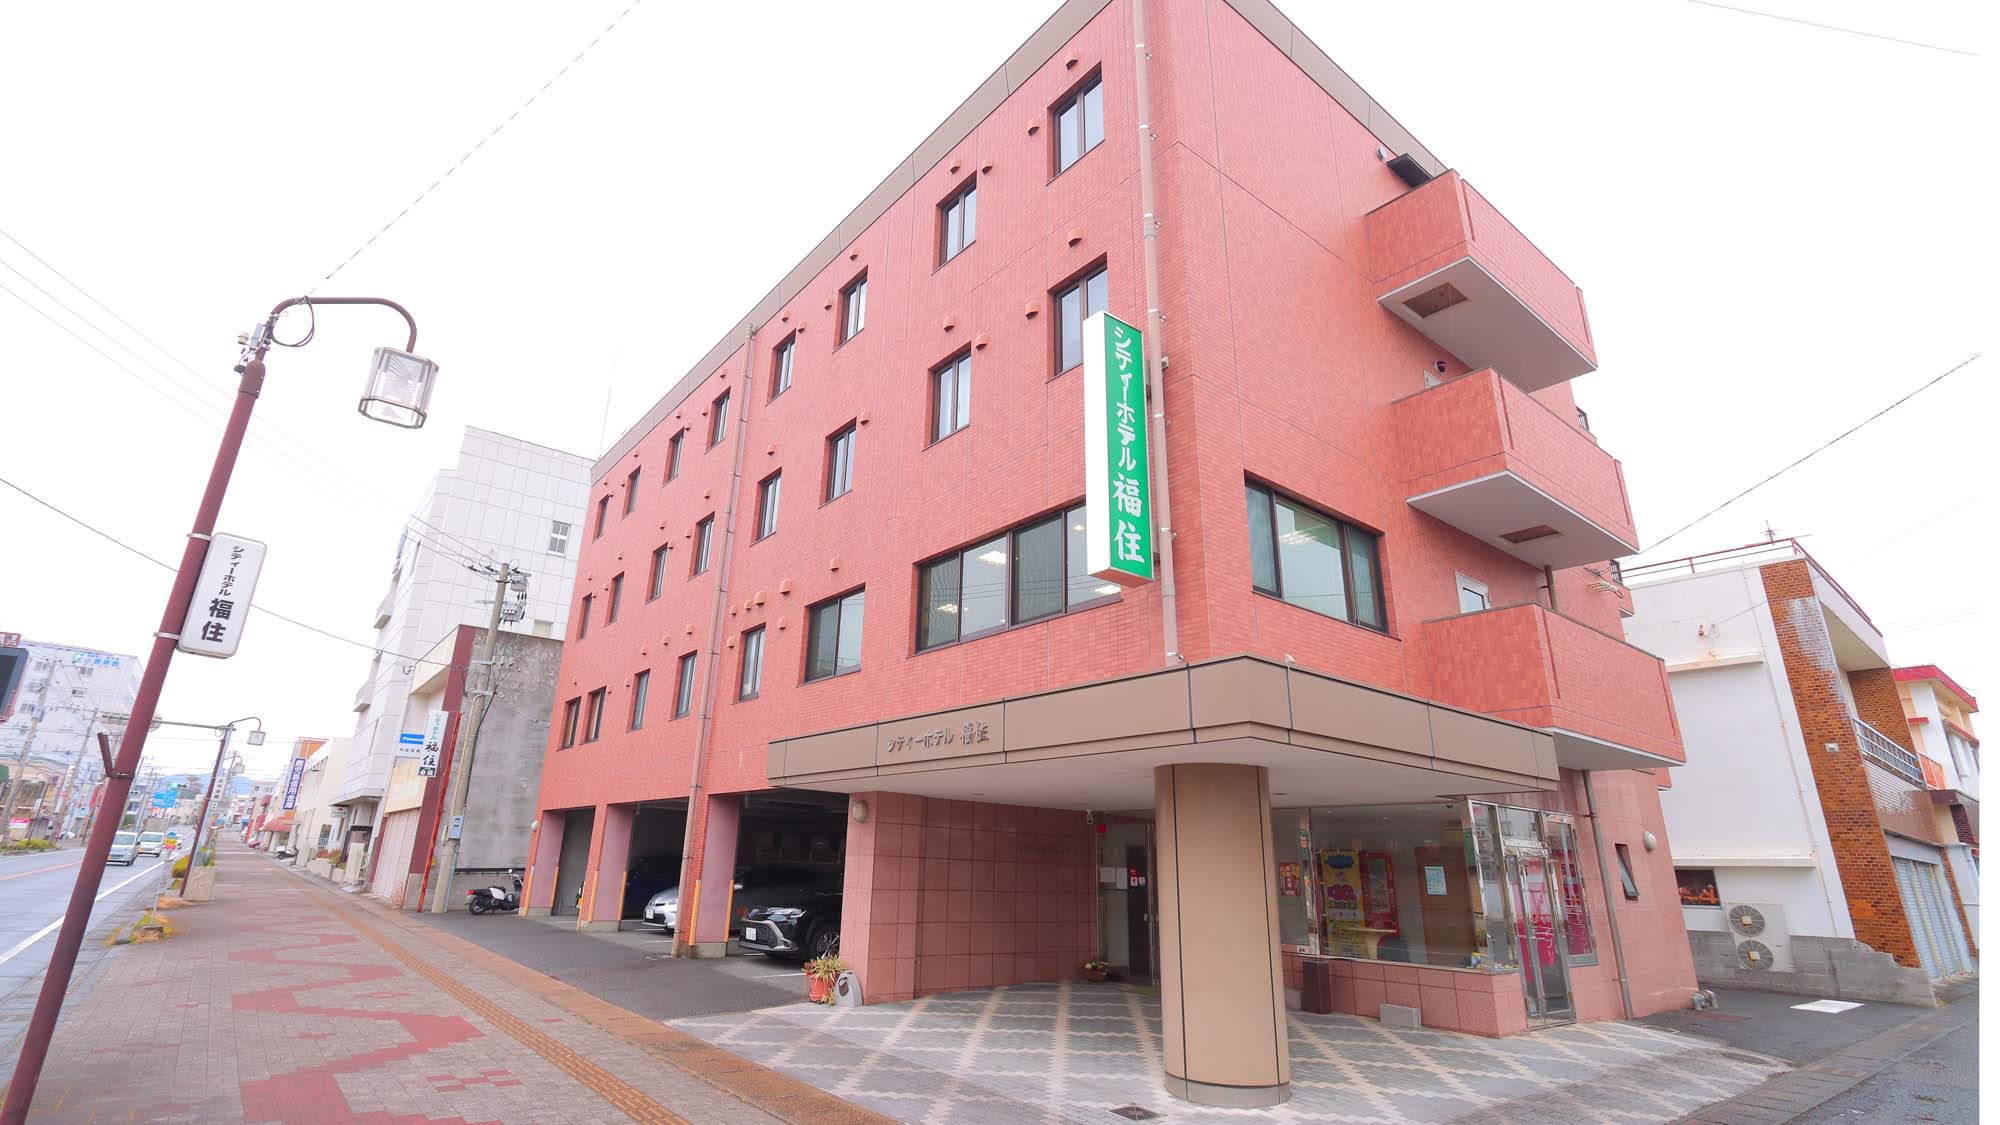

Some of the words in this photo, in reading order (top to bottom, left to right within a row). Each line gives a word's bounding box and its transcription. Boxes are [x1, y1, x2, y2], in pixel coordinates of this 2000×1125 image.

[887, 728, 954, 753] シティーホテル
[960, 720, 991, 745] 福住
